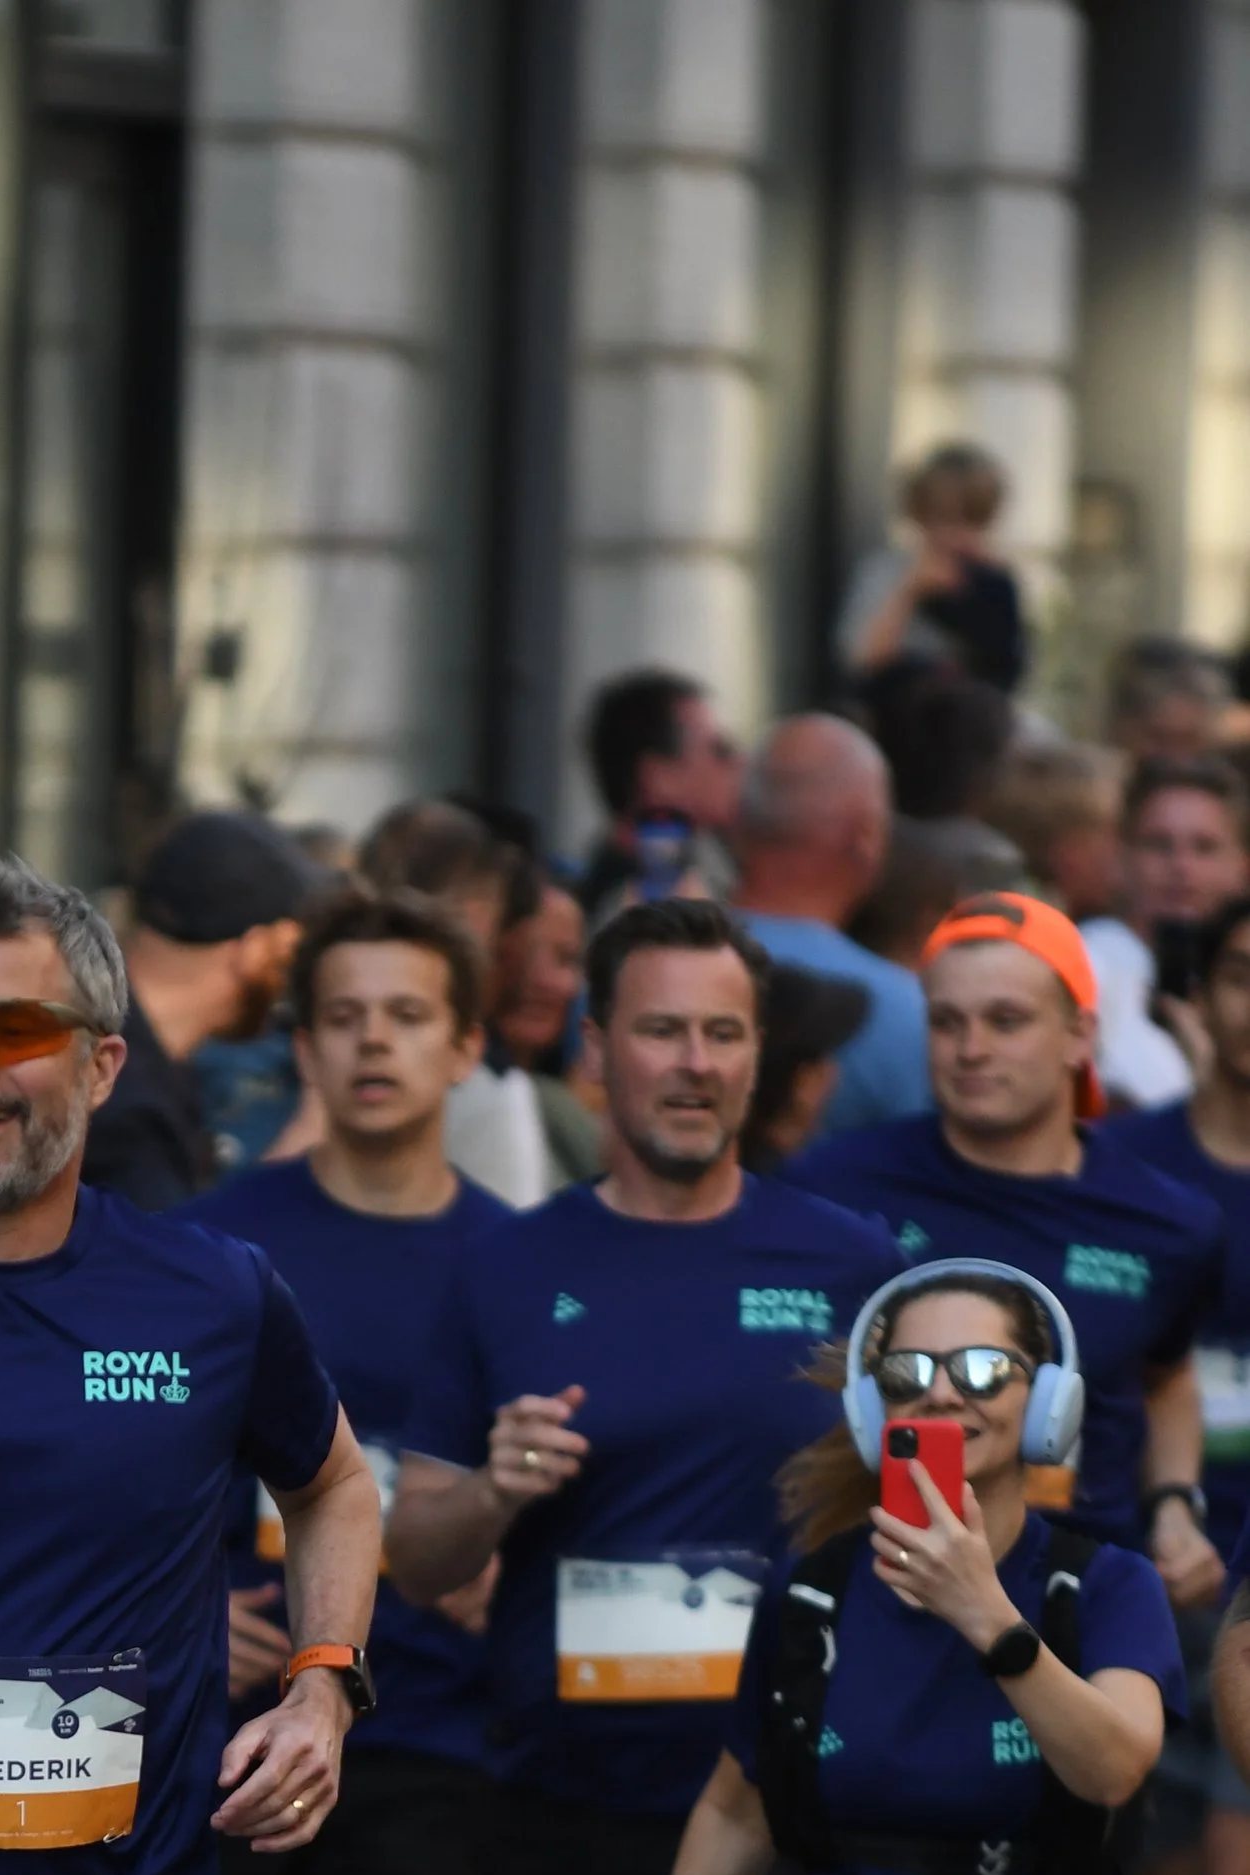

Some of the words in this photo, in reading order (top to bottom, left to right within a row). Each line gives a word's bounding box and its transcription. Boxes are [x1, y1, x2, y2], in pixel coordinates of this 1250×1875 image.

[740, 1288, 833, 1311] ROYAL
[740, 1307, 804, 1329] RUN
[83, 1350, 190, 1376] ROYAL
[84, 1377, 156, 1402] RUN
[57, 1715, 75, 1727] 10
[16, 1800, 26, 1827] 1
